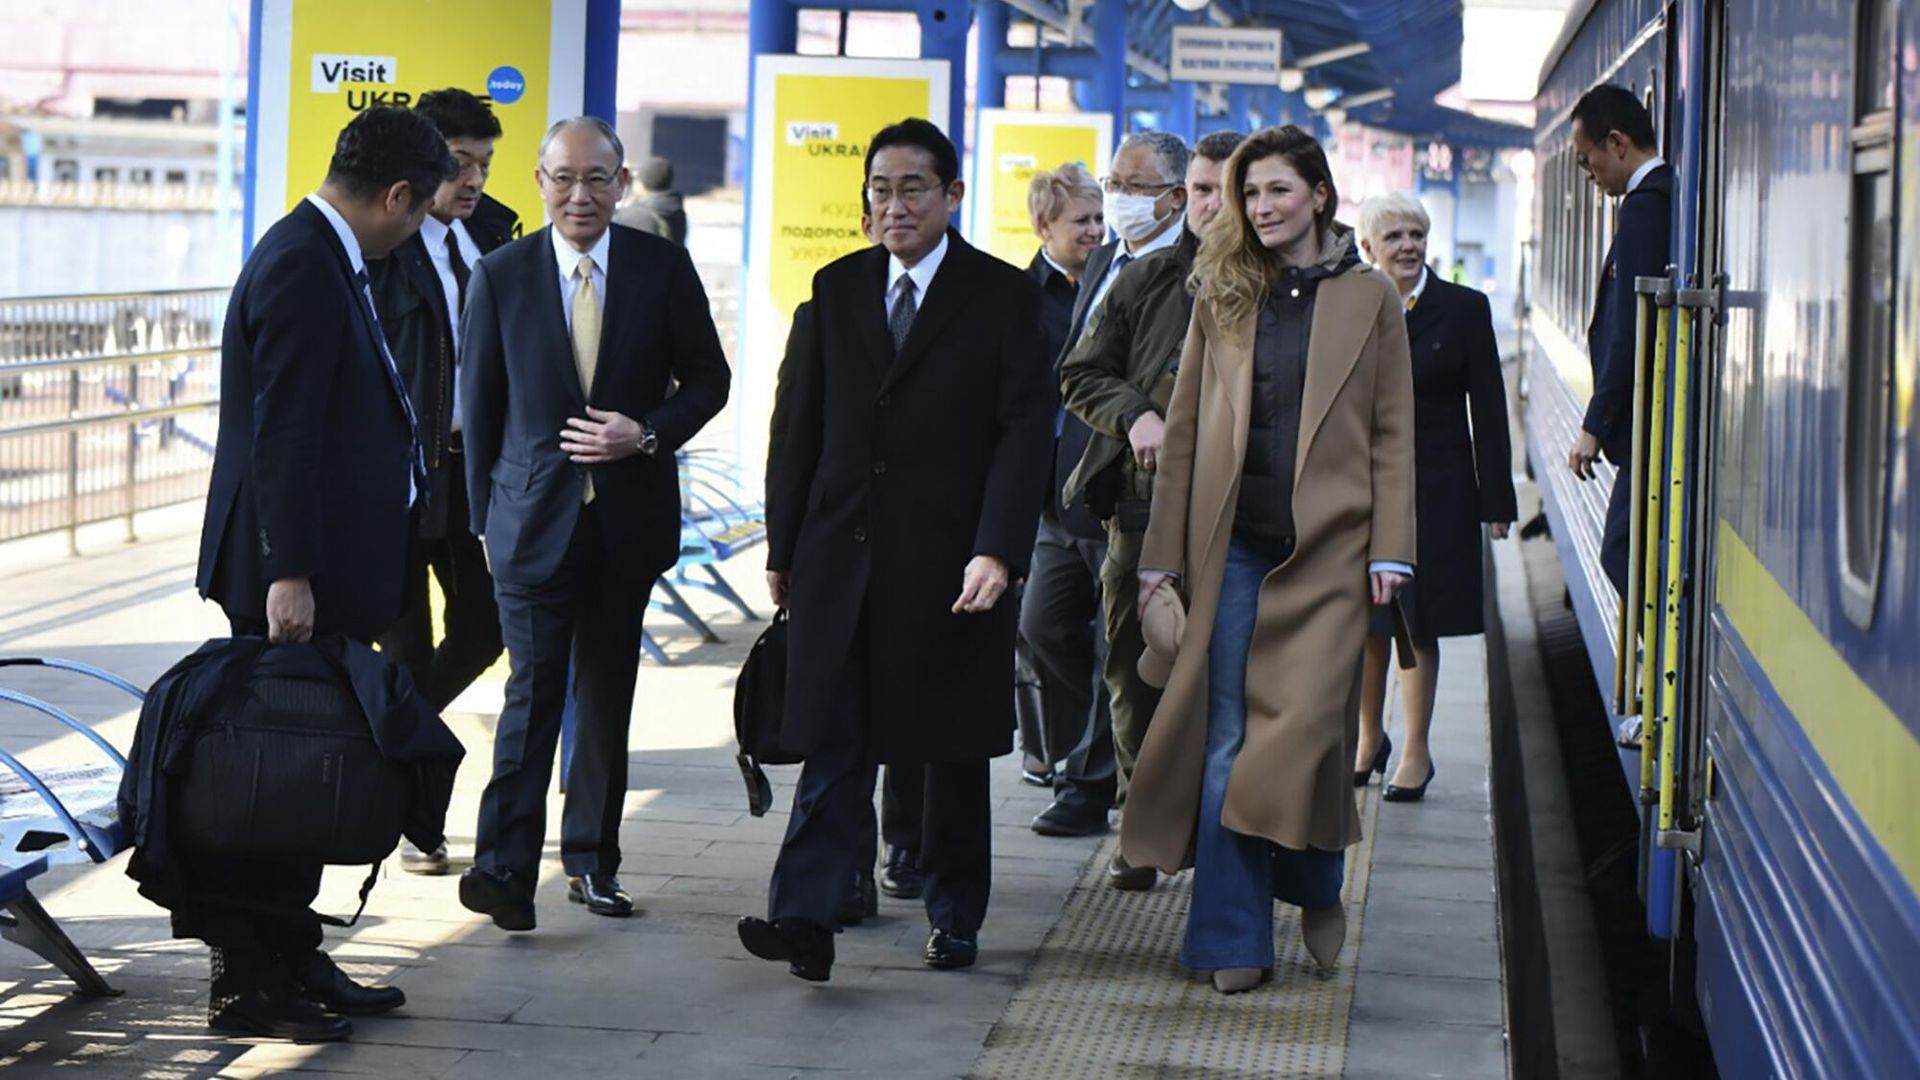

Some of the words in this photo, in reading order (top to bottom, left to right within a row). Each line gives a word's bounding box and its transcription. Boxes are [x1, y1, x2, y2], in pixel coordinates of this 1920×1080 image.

[321, 60, 387, 83] Visit
[792, 125, 833, 140] Visit
[808, 143, 868, 157] UKRAI
[821, 202, 860, 219] КУД
[781, 225, 859, 239] ПОДОРОЖ
